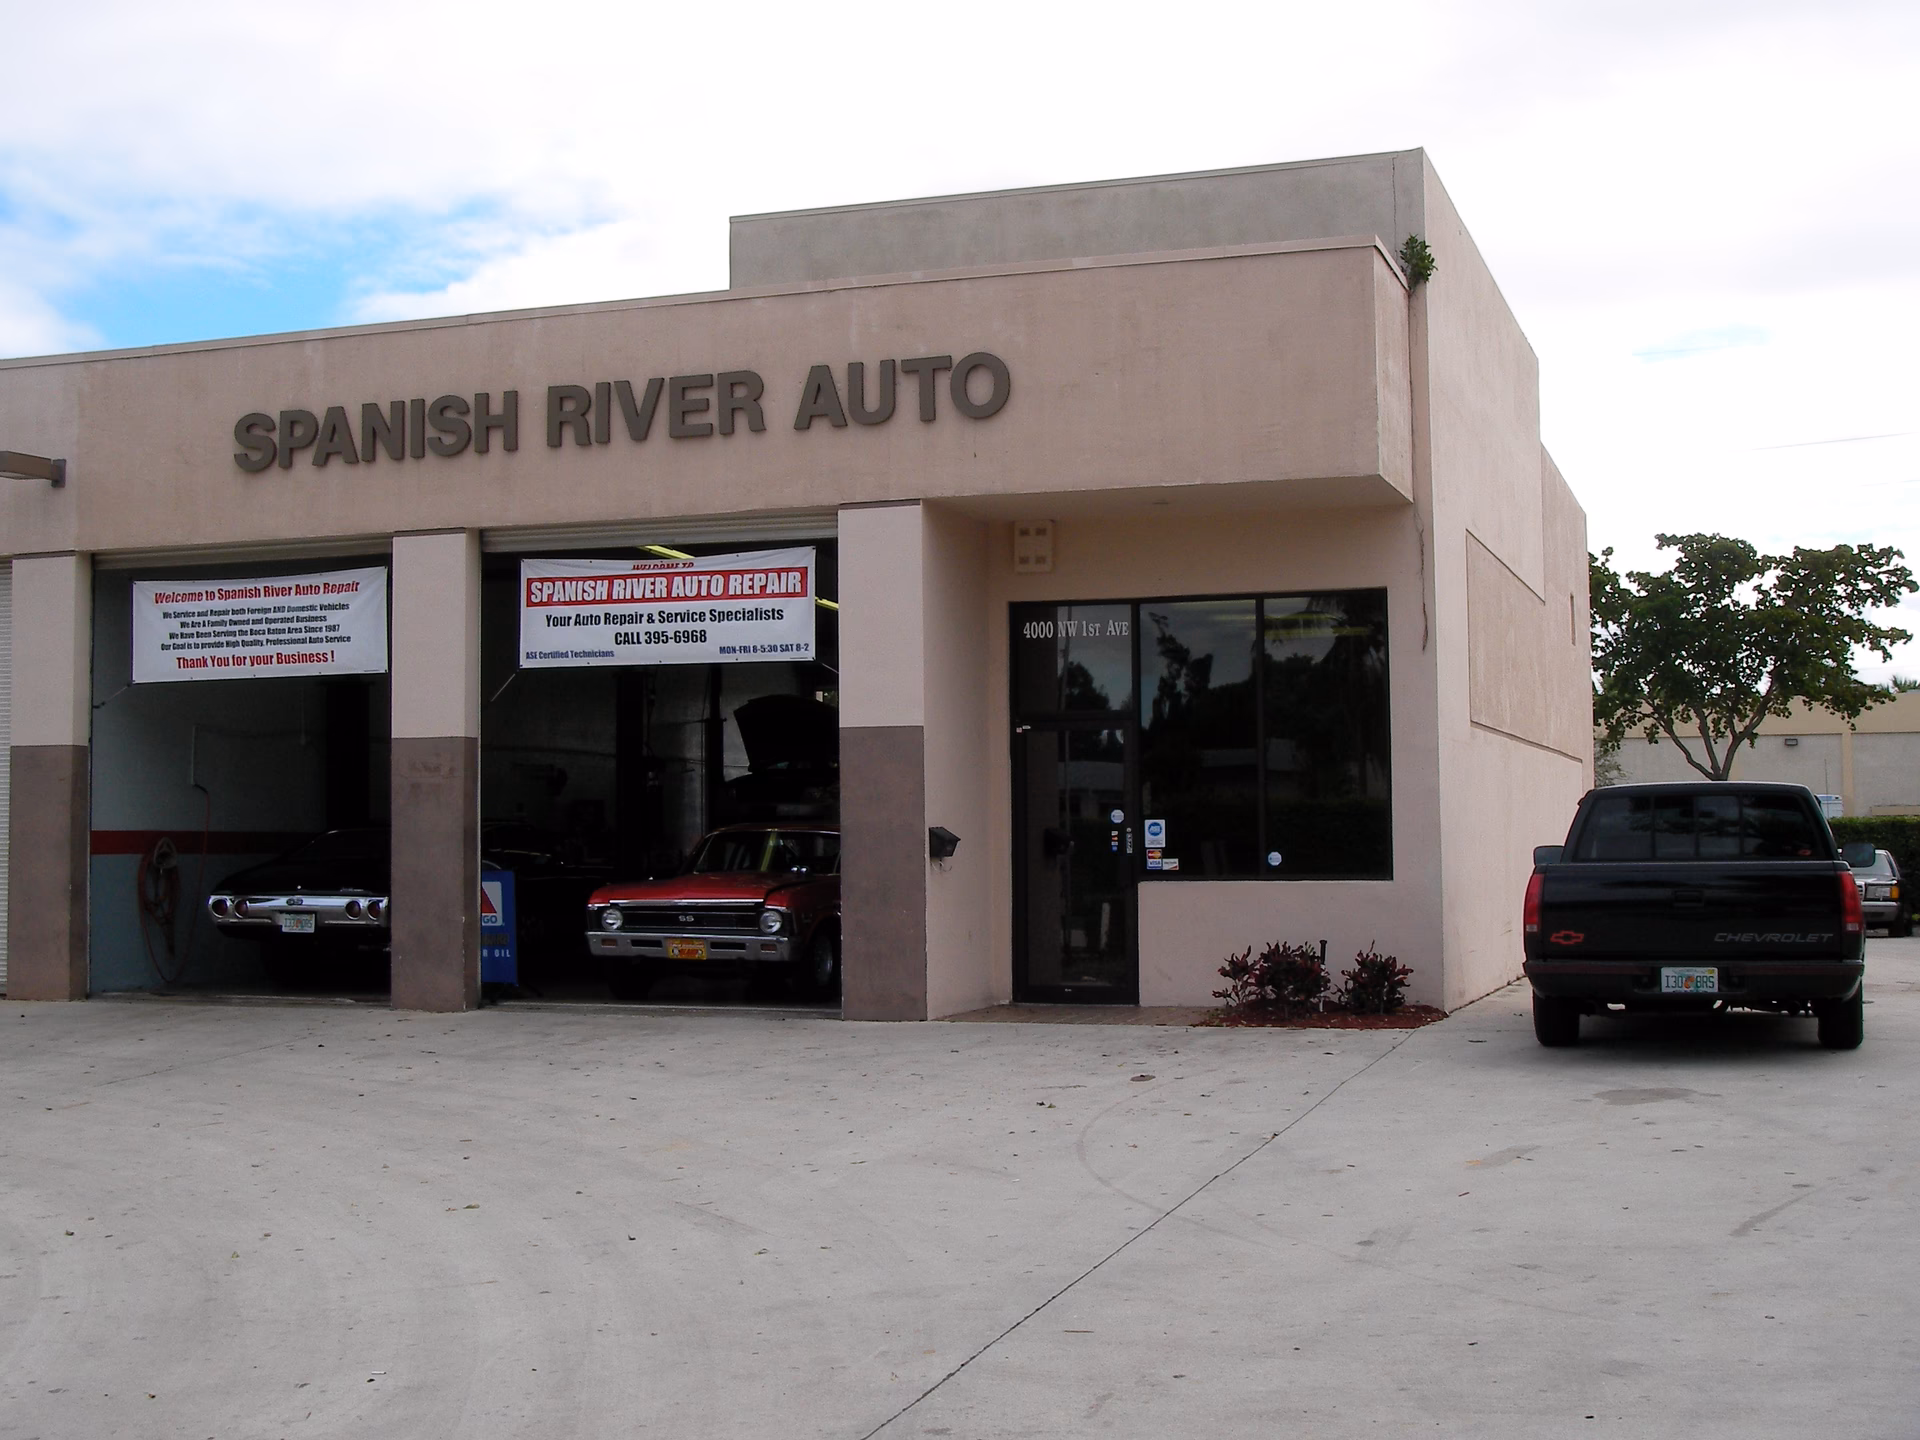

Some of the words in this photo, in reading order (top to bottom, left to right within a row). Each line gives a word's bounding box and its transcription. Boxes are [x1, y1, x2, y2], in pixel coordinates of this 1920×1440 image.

[232, 390, 519, 473] SPANISH
[545, 368, 766, 448] RIVER
[793, 350, 1011, 432] AUTO
[155, 591, 203, 604] Welcome
[205, 590, 215, 601] to
[217, 586, 261, 601] Spanish
[264, 585, 292, 597] River
[295, 584, 320, 596] Auto
[323, 581, 360, 594] Repair
[531, 580, 608, 603] SPANISH
[612, 577, 668, 599] RIVER
[671, 574, 724, 598] AUTO
[728, 572, 801, 595] REPAIR
[162, 611, 172, 619] We
[173, 610, 196, 618] Service
[210, 609, 230, 617] Repair
[231, 608, 246, 616] both
[247, 606, 271, 615] Foreign
[287, 604, 318, 613] Domestic
[319, 603, 349, 611] Vehicles
[546, 614, 572, 627] Your
[574, 614, 601, 626] Auto
[604, 612, 644, 626] Repair
[646, 613, 655, 624] &
[658, 610, 706, 623] Service
[709, 608, 784, 623] Specialists
[208, 619, 227, 627] Family
[229, 618, 250, 626] Owned
[265, 616, 294, 625] Operated
[296, 615, 327, 623] Business
[169, 632, 179, 640] We
[213, 630, 236, 638] Serving
[250, 628, 266, 636] Boca
[268, 626, 286, 635] Raton
[288, 626, 302, 634] Area
[304, 625, 323, 633] Since
[325, 624, 340, 632] 1987
[615, 632, 642, 645] CALL
[645, 630, 707, 644] 395-6968
[1024, 621, 1053, 638] 4000
[1058, 621, 1078, 637] NW
[161, 643, 171, 651] Our
[172, 642, 186, 650] Goal
[201, 640, 224, 650] provide
[226, 640, 240, 648] High
[266, 637, 307, 646] Professional
[309, 636, 323, 644] Auto
[325, 635, 351, 643] Service
[719, 645, 751, 654] MON-FRI
[752, 644, 778, 653] 8-5:30
[780, 644, 794, 652] SAT
[796, 643, 809, 652] 8-2
[176, 656, 208, 669] Thank
[210, 655, 229, 667] You
[232, 655, 247, 666] for
[249, 654, 274, 667] your
[276, 651, 328, 664] Business
[539, 650, 569, 659] Certified
[570, 649, 614, 658] Technicians
[1714, 932, 1833, 942] CHEVROLET
[494, 949, 510, 957] OIL
